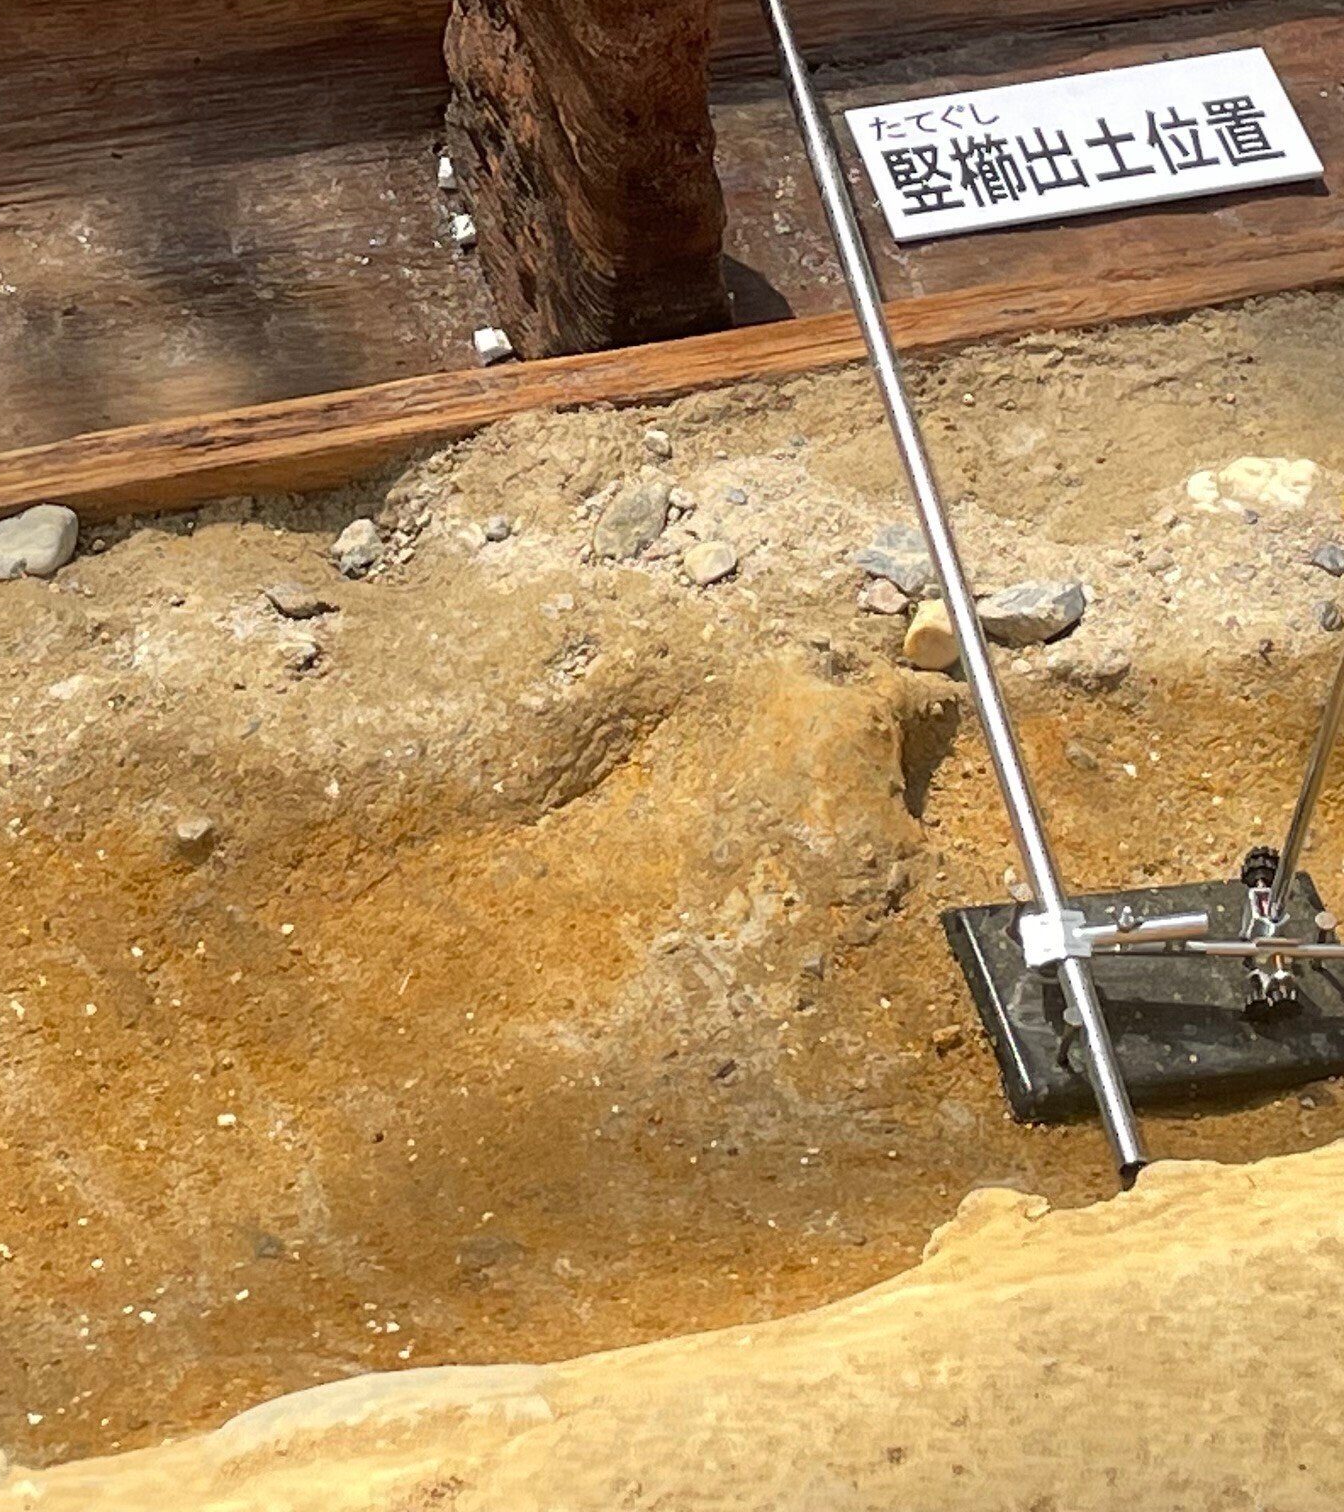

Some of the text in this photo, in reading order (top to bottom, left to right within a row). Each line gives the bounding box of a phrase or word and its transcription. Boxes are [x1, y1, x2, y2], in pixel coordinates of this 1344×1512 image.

[869, 102, 1001, 141] たてぐし
[880, 94, 1287, 217] 竪櫛出土位置
